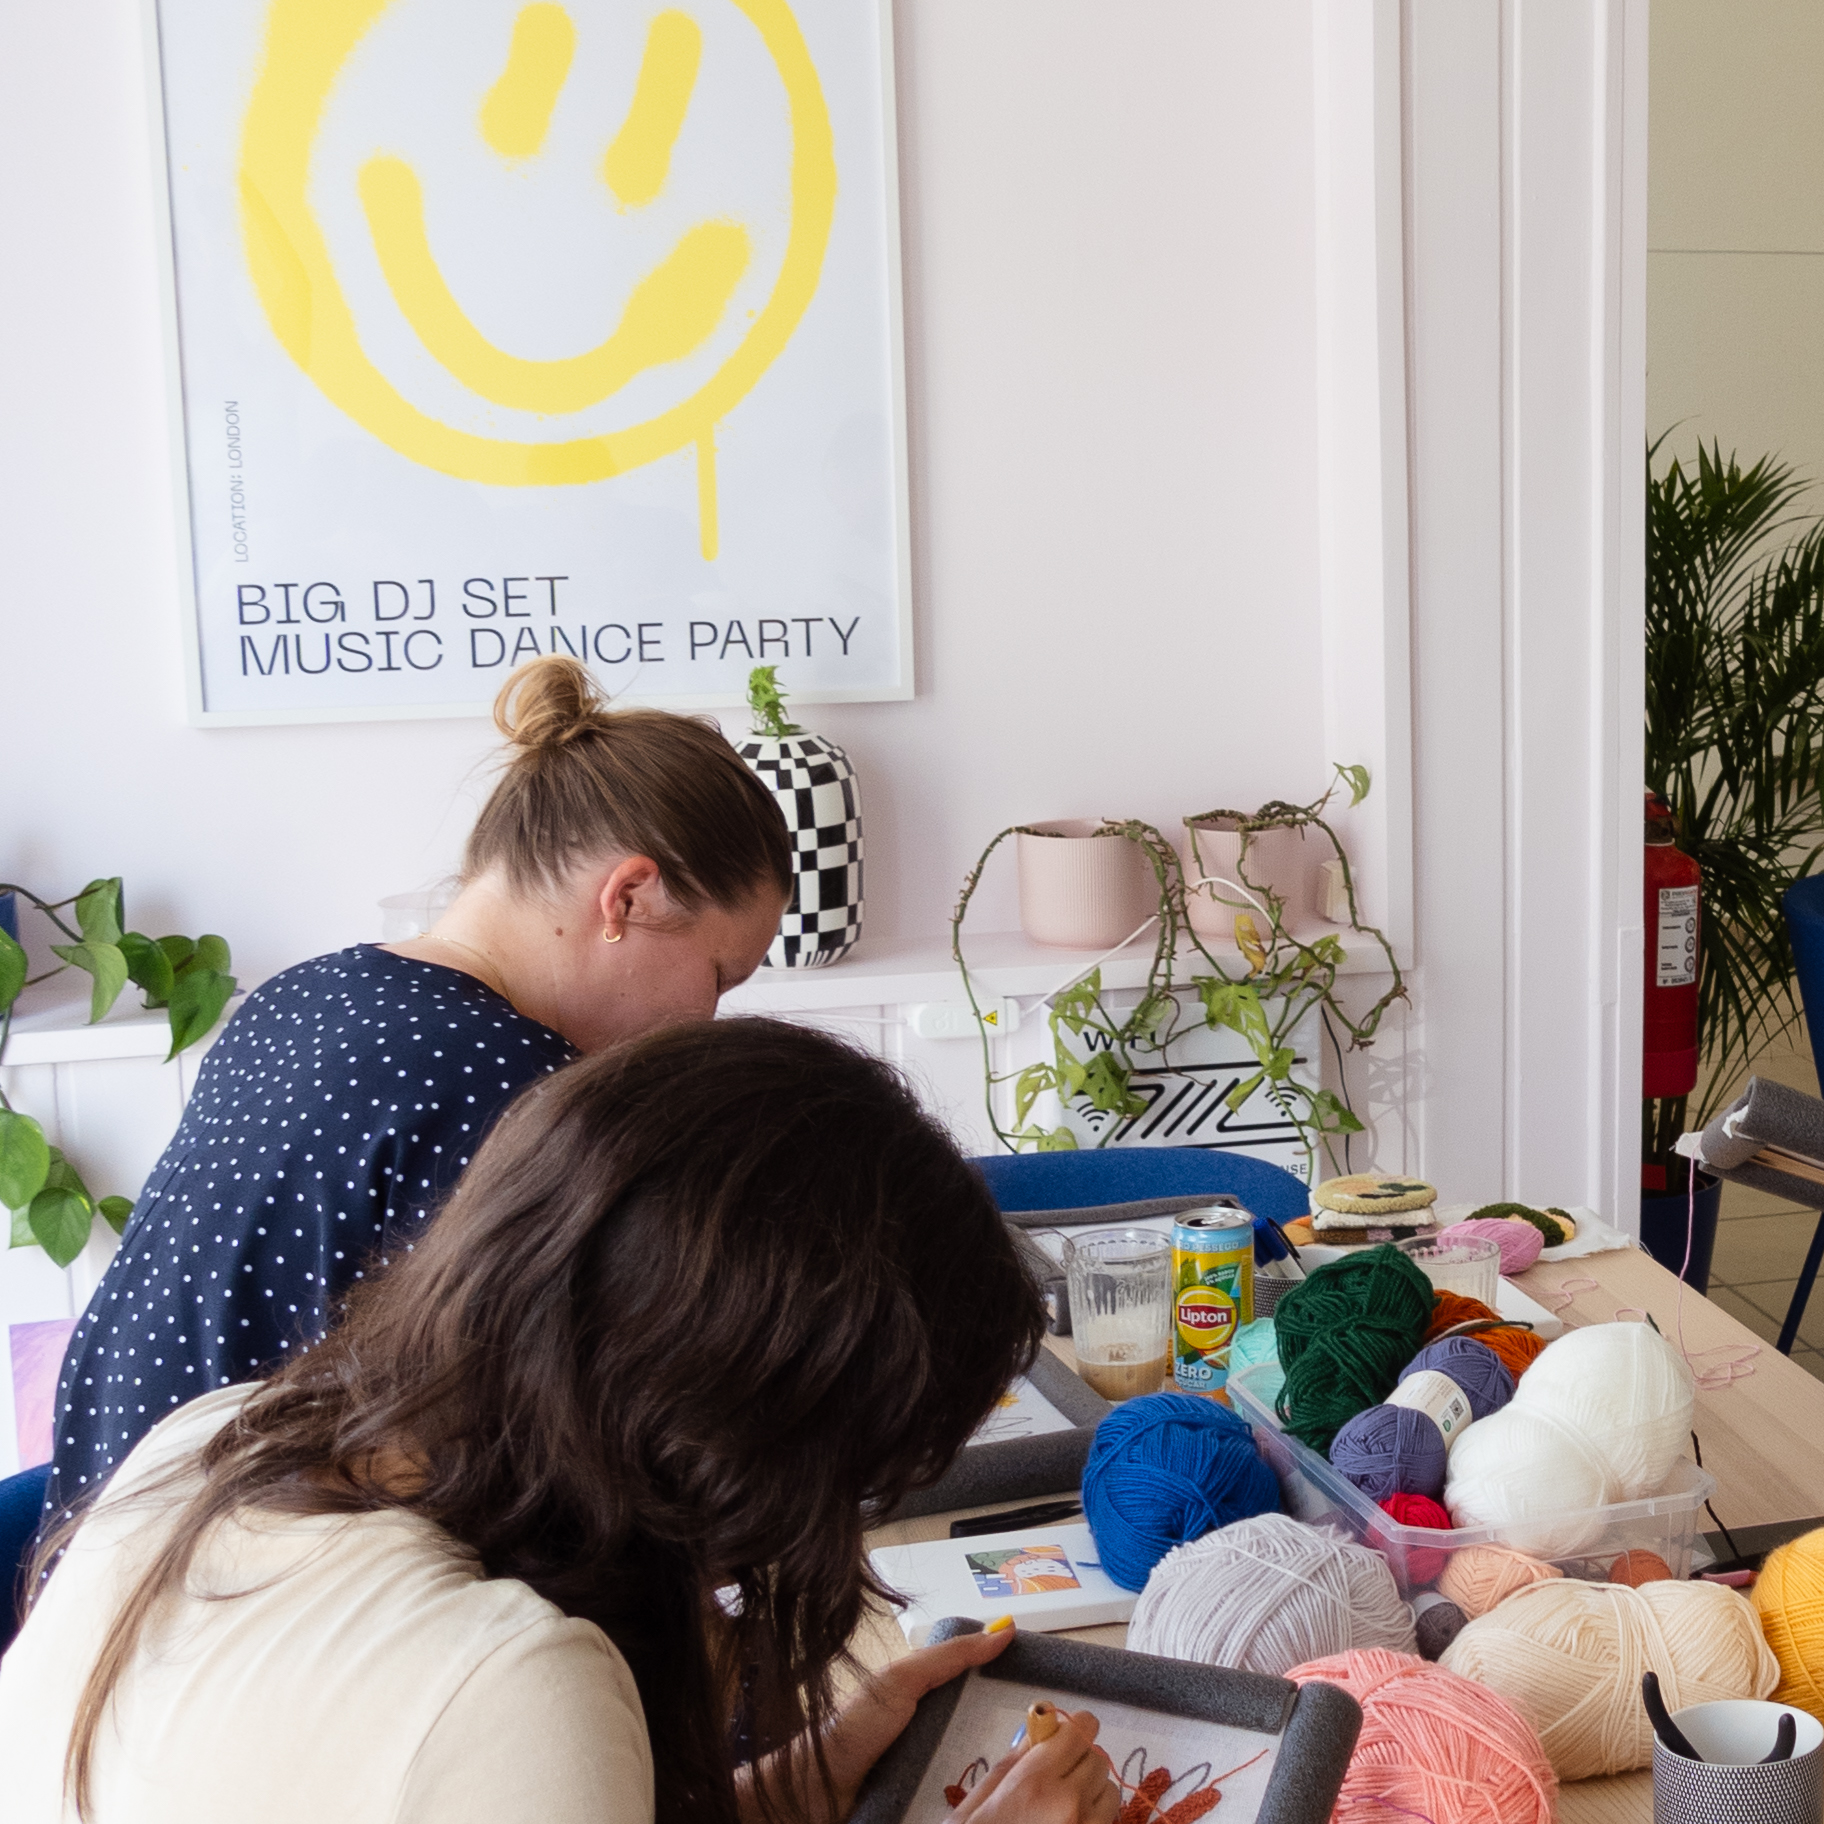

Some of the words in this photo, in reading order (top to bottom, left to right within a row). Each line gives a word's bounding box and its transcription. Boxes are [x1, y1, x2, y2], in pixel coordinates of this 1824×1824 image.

[224, 400, 243, 469] LONDON
[230, 474, 250, 564] LOCATION:
[236, 581, 346, 626] BIG
[372, 579, 436, 622] DJ
[461, 576, 570, 619] SET
[239, 630, 443, 677] MUSIC
[469, 621, 666, 671] DANCE
[687, 615, 862, 662] PARTY
[1180, 1307, 1228, 1326] Lipton
[1174, 1362, 1213, 1381] ZERO
